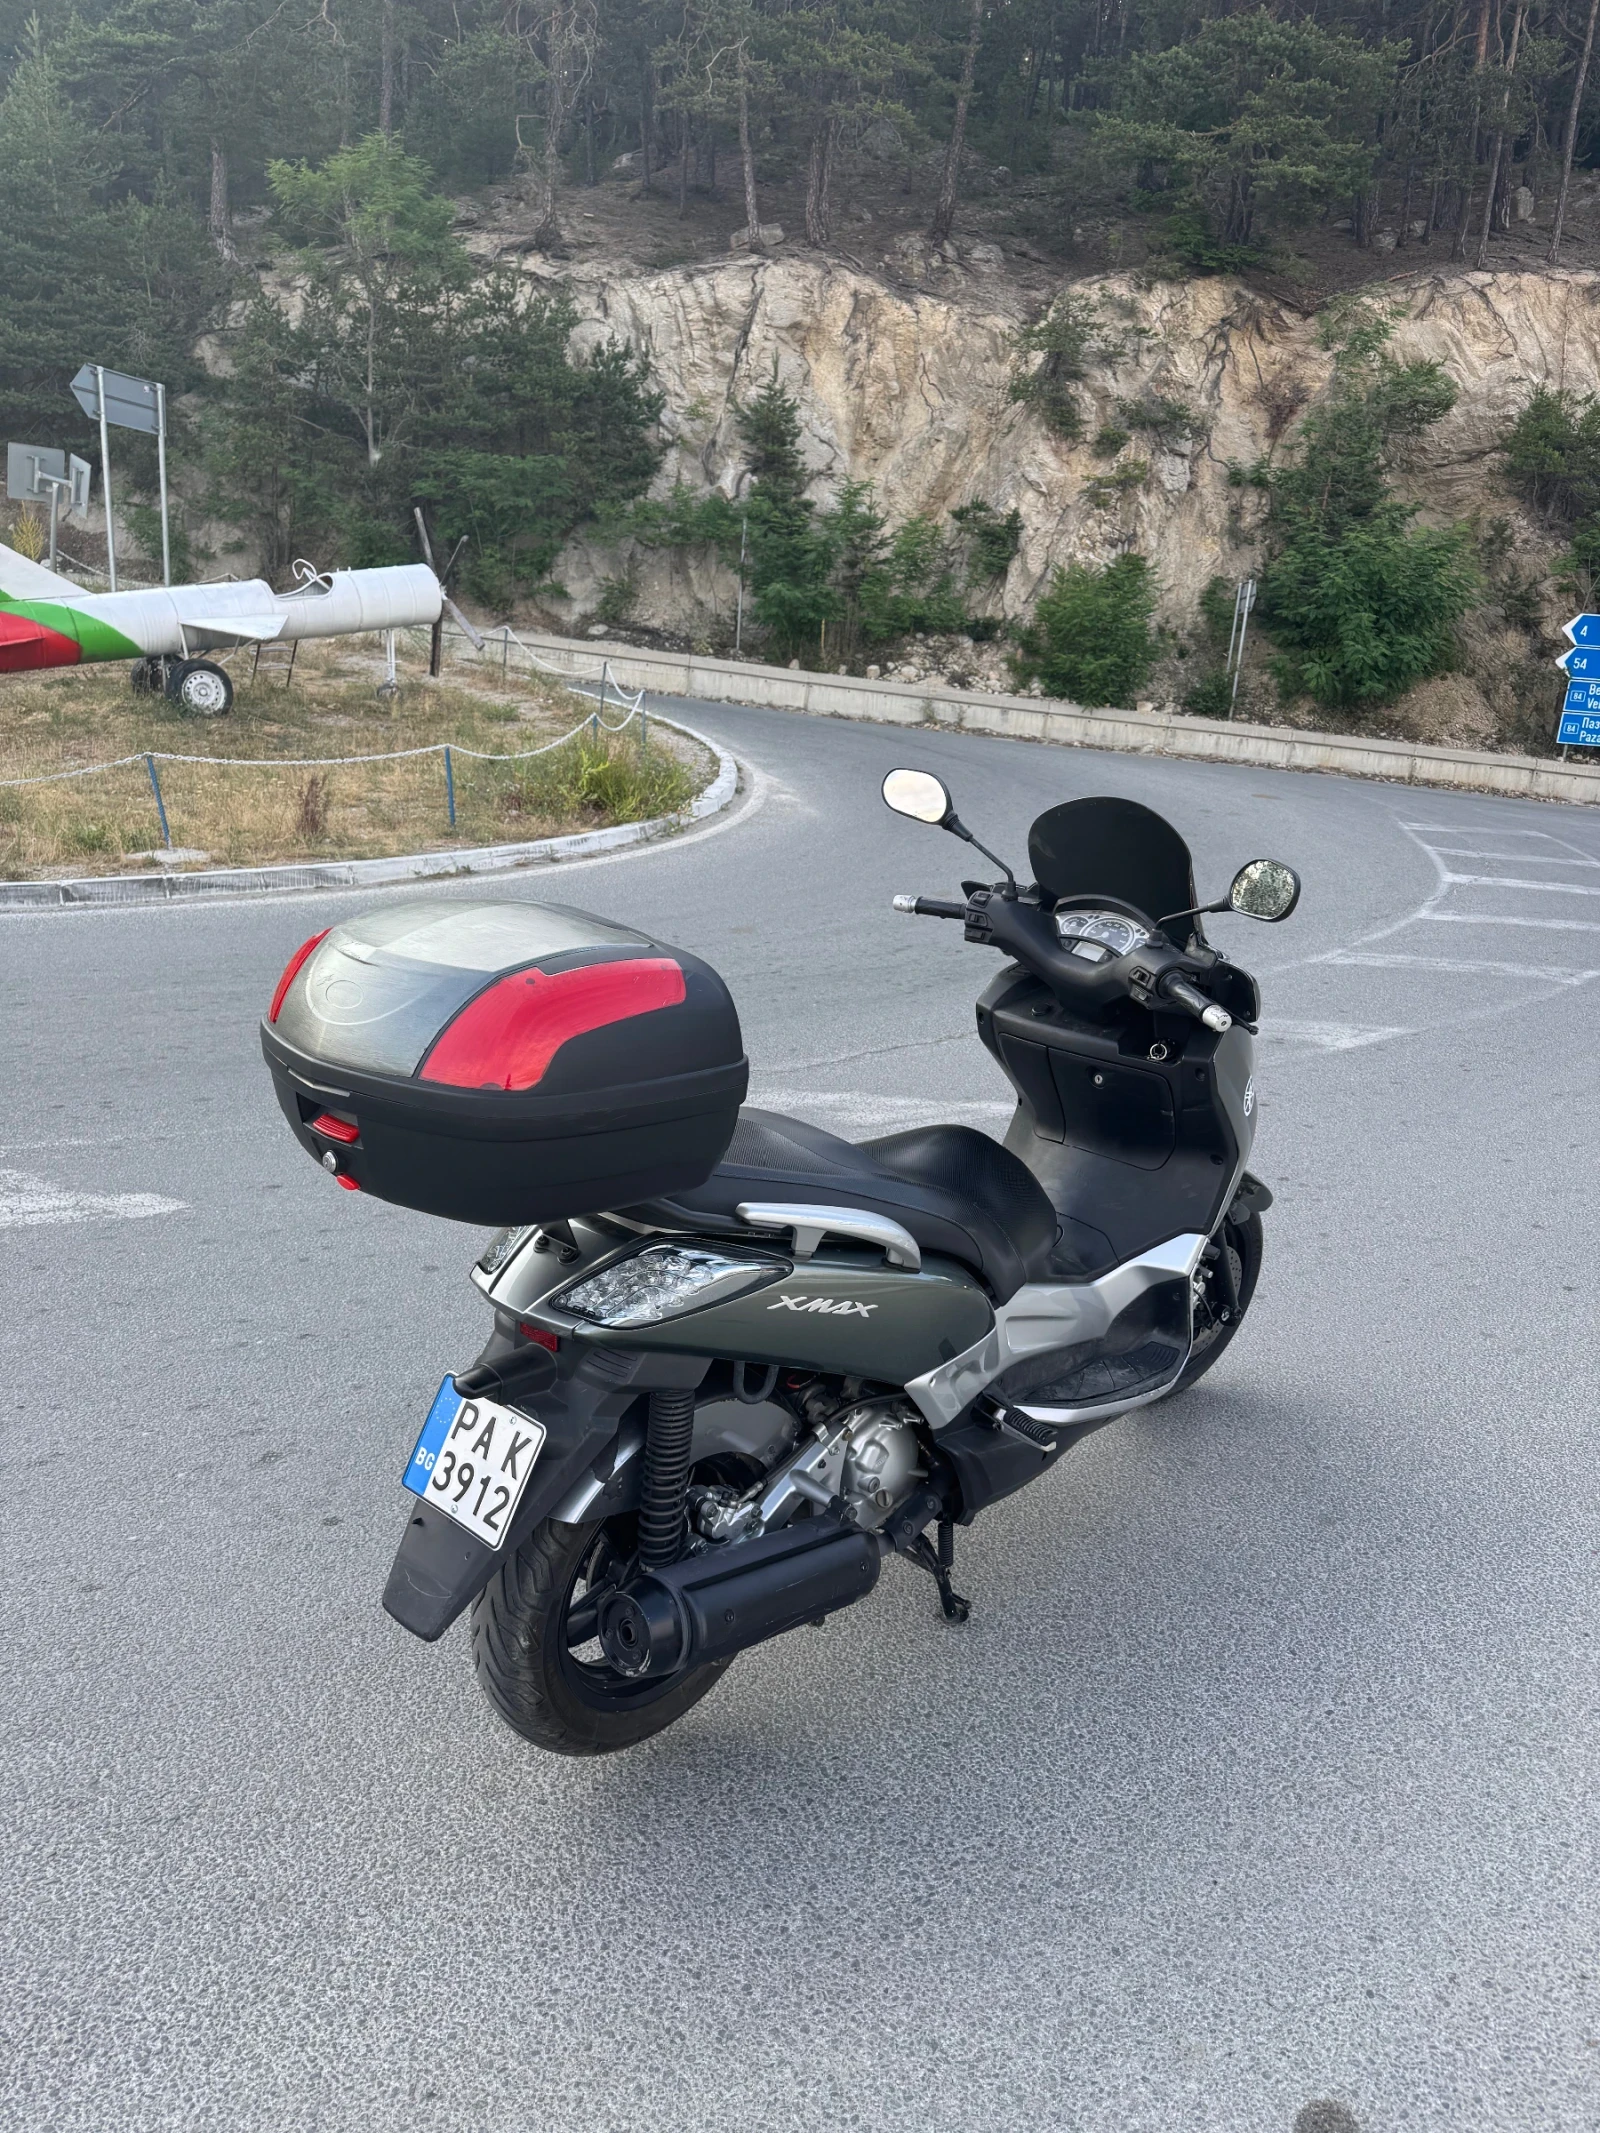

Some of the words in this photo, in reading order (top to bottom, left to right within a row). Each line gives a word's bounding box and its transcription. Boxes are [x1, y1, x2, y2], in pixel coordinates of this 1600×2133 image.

[1580, 625, 1588, 637] 4
[1573, 657, 1587, 670] 54
[1573, 692, 1583, 700] 84
[1566, 724, 1576, 732] 84
[766, 1295, 879, 1318] XMAX
[450, 1400, 533, 1481] PAK
[414, 1446, 436, 1471] BG
[432, 1450, 510, 1532] 3912
